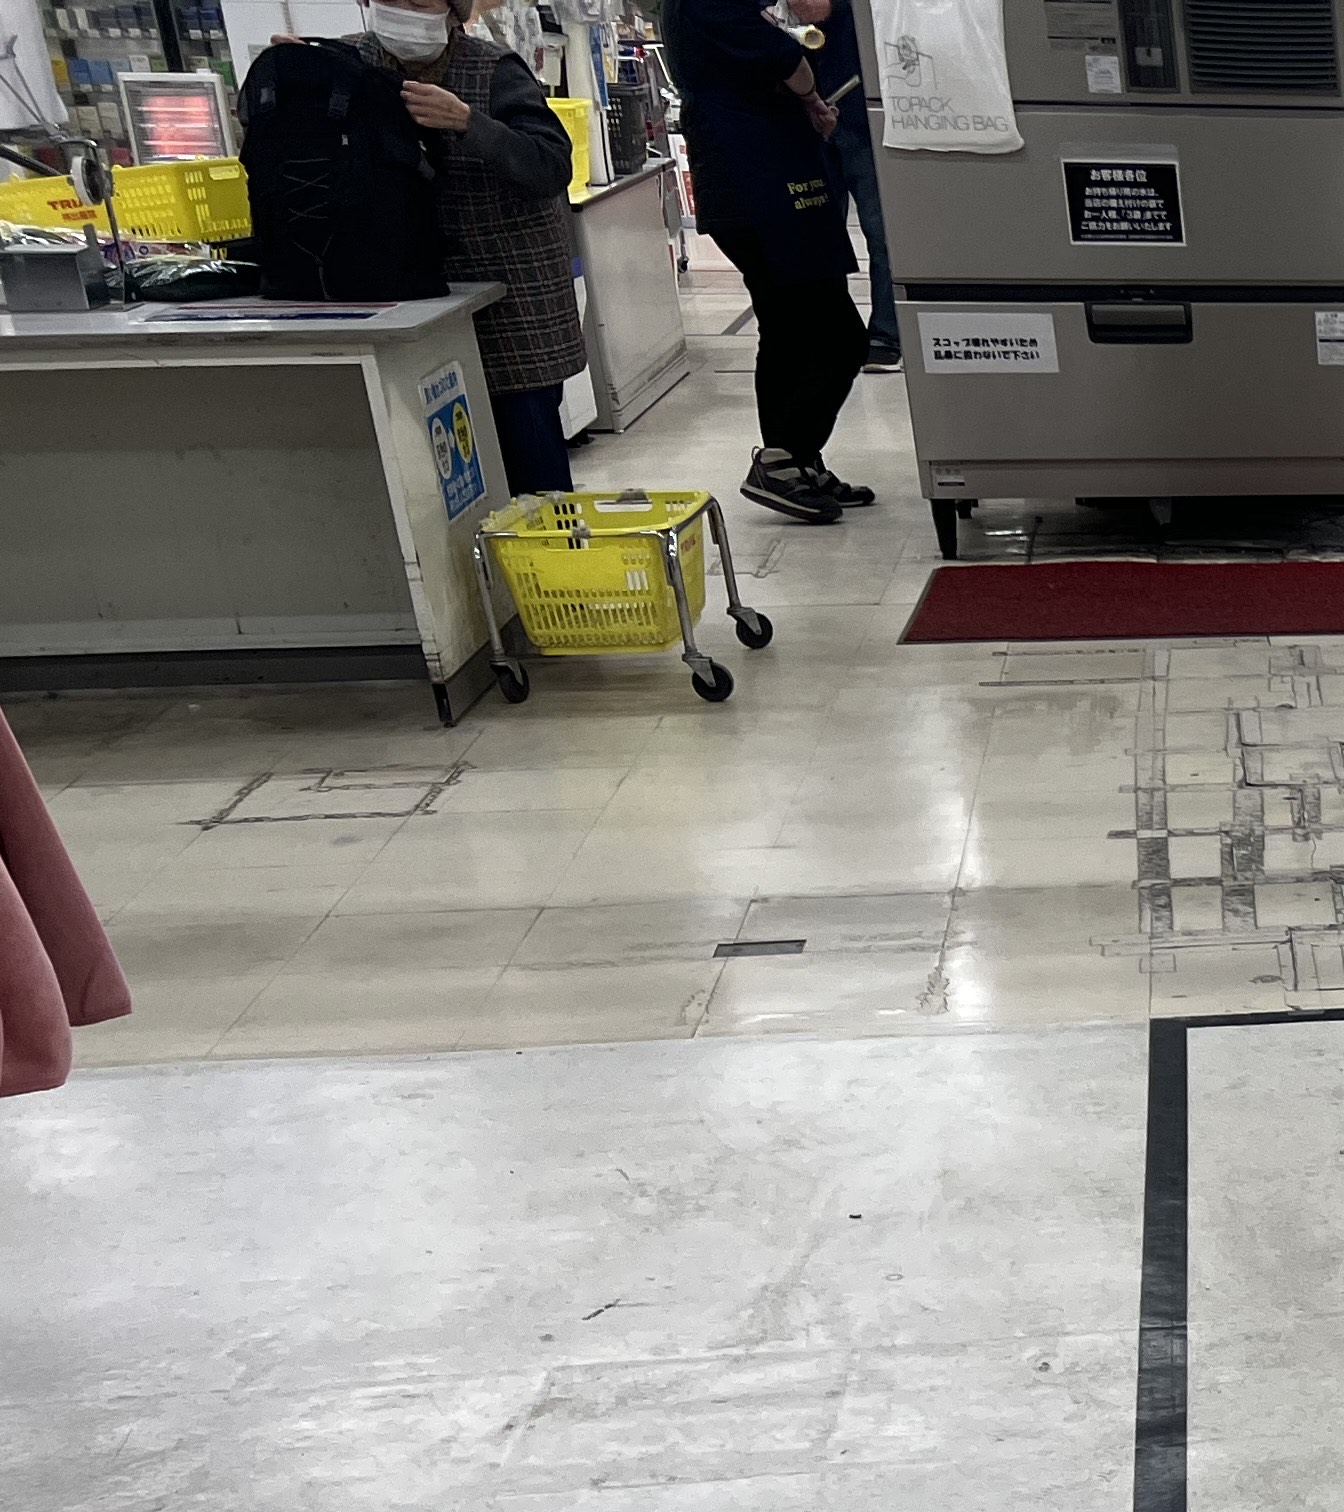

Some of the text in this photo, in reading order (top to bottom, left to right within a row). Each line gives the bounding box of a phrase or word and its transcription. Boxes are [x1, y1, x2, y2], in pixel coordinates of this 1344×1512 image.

[890, 95, 955, 113] TOPACK
[891, 114, 1009, 133] HANGING BAG
